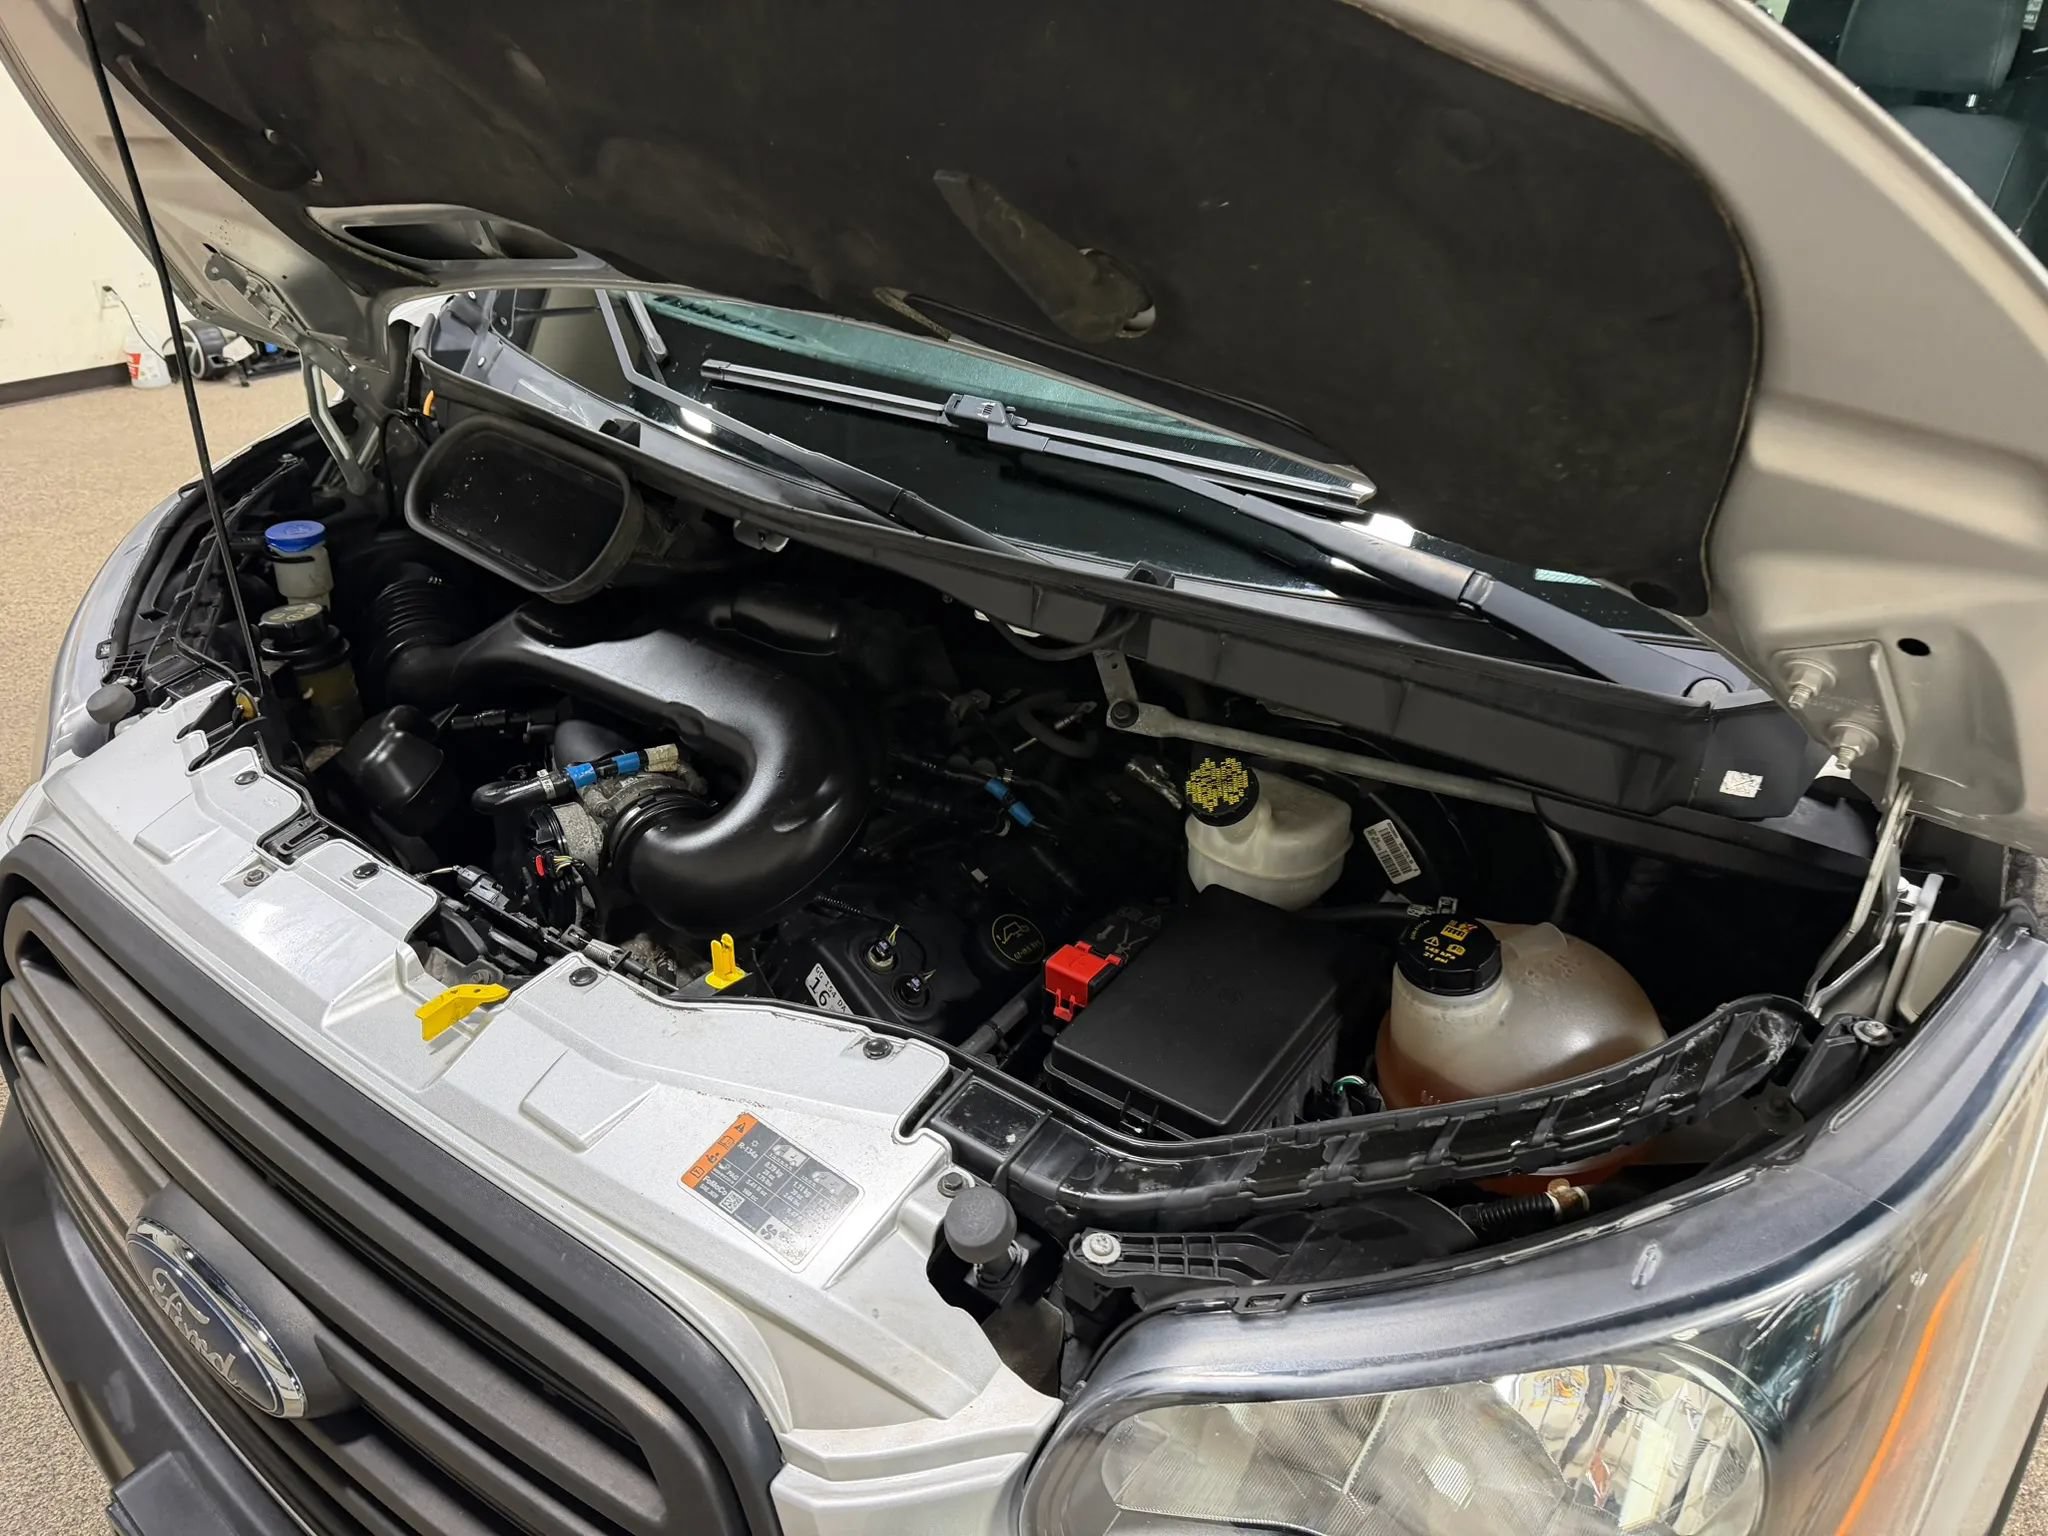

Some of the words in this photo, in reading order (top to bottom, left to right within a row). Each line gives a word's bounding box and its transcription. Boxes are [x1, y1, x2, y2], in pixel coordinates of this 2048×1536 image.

[809, 976, 831, 1006] 16
[737, 1142, 759, 1159] R-134a
[726, 1170, 738, 1181] PAG
[774, 1169, 784, 1178] kg
[702, 1175, 728, 1196] FoMoCo
[802, 1188, 812, 1198] kg
[149, 1267, 238, 1386] Ford
